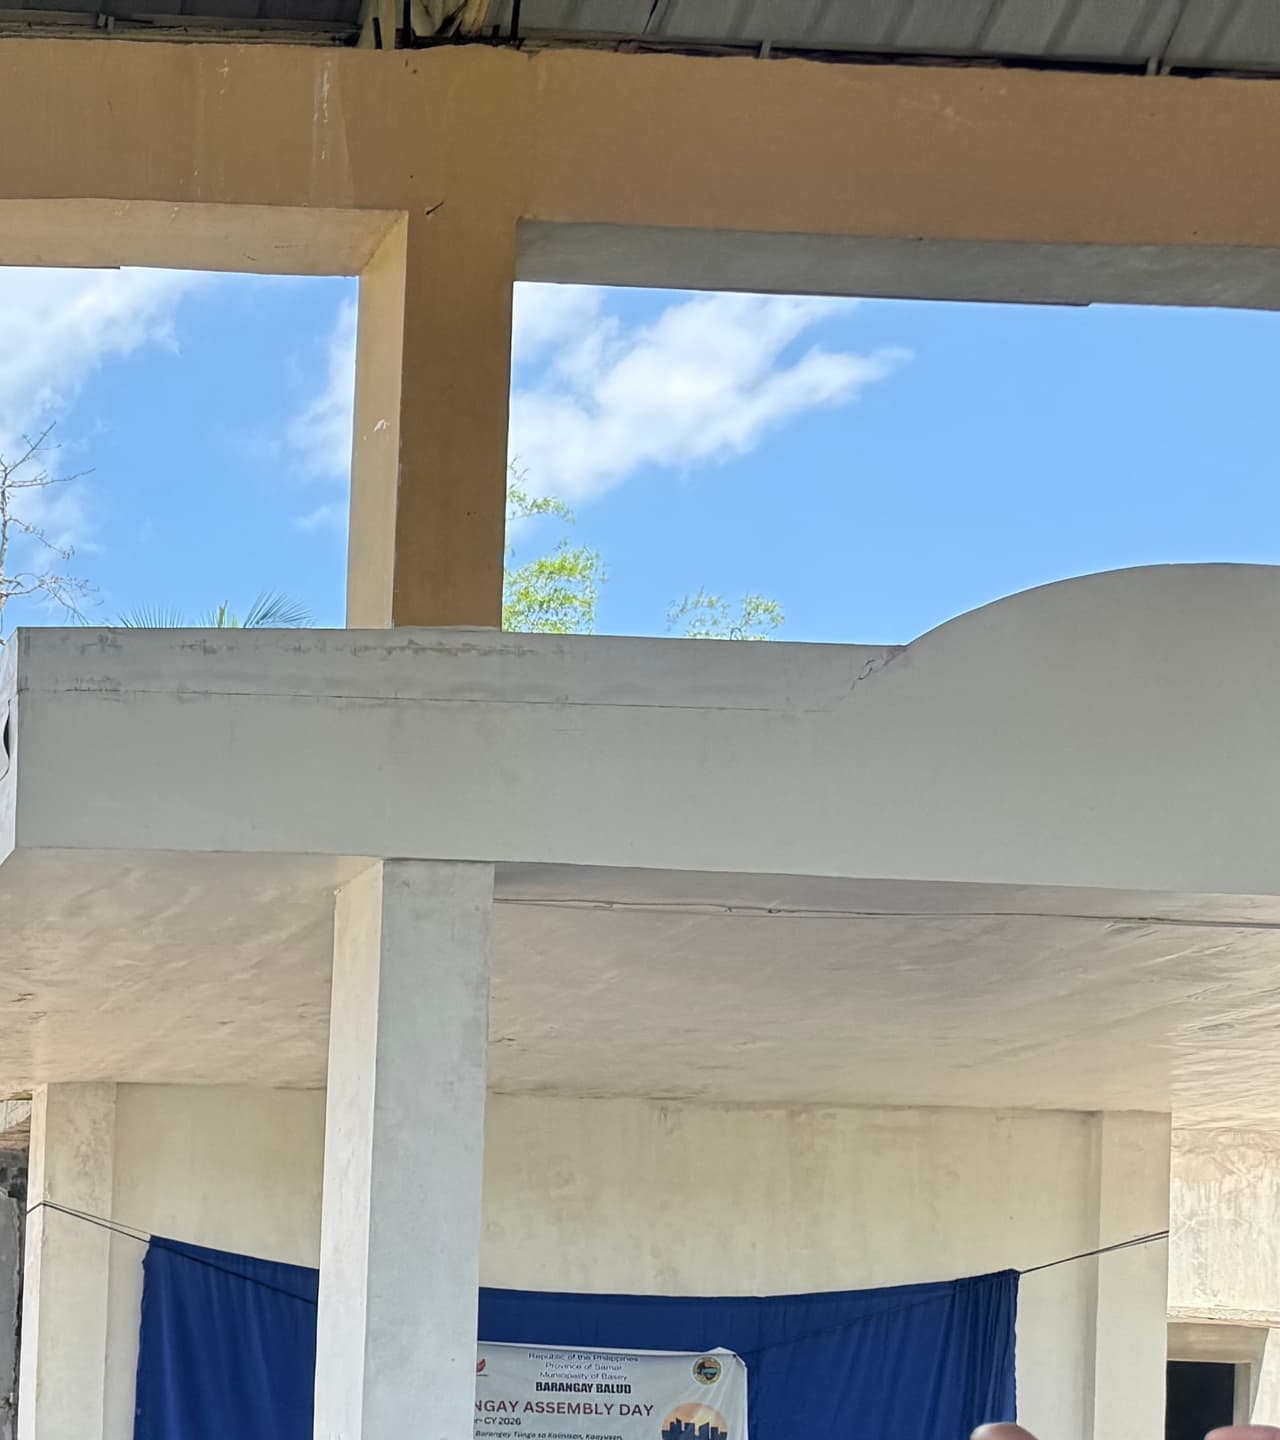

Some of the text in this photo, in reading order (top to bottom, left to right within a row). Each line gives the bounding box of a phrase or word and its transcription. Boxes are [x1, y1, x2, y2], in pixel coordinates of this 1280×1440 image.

[578, 1353, 590, 1361] the
[593, 1354, 639, 1363] Philippines
[545, 1362, 582, 1370] Province
[595, 1363, 622, 1371] Samar
[539, 1371, 588, 1381] Municipality
[535, 1381, 632, 1395] BARANGAY BALUD
[523, 1401, 614, 1415] ASSEMBLY
[619, 1404, 655, 1417] DAY
[484, 1417, 498, 1425] CY
[499, 1417, 521, 1426] 2026
